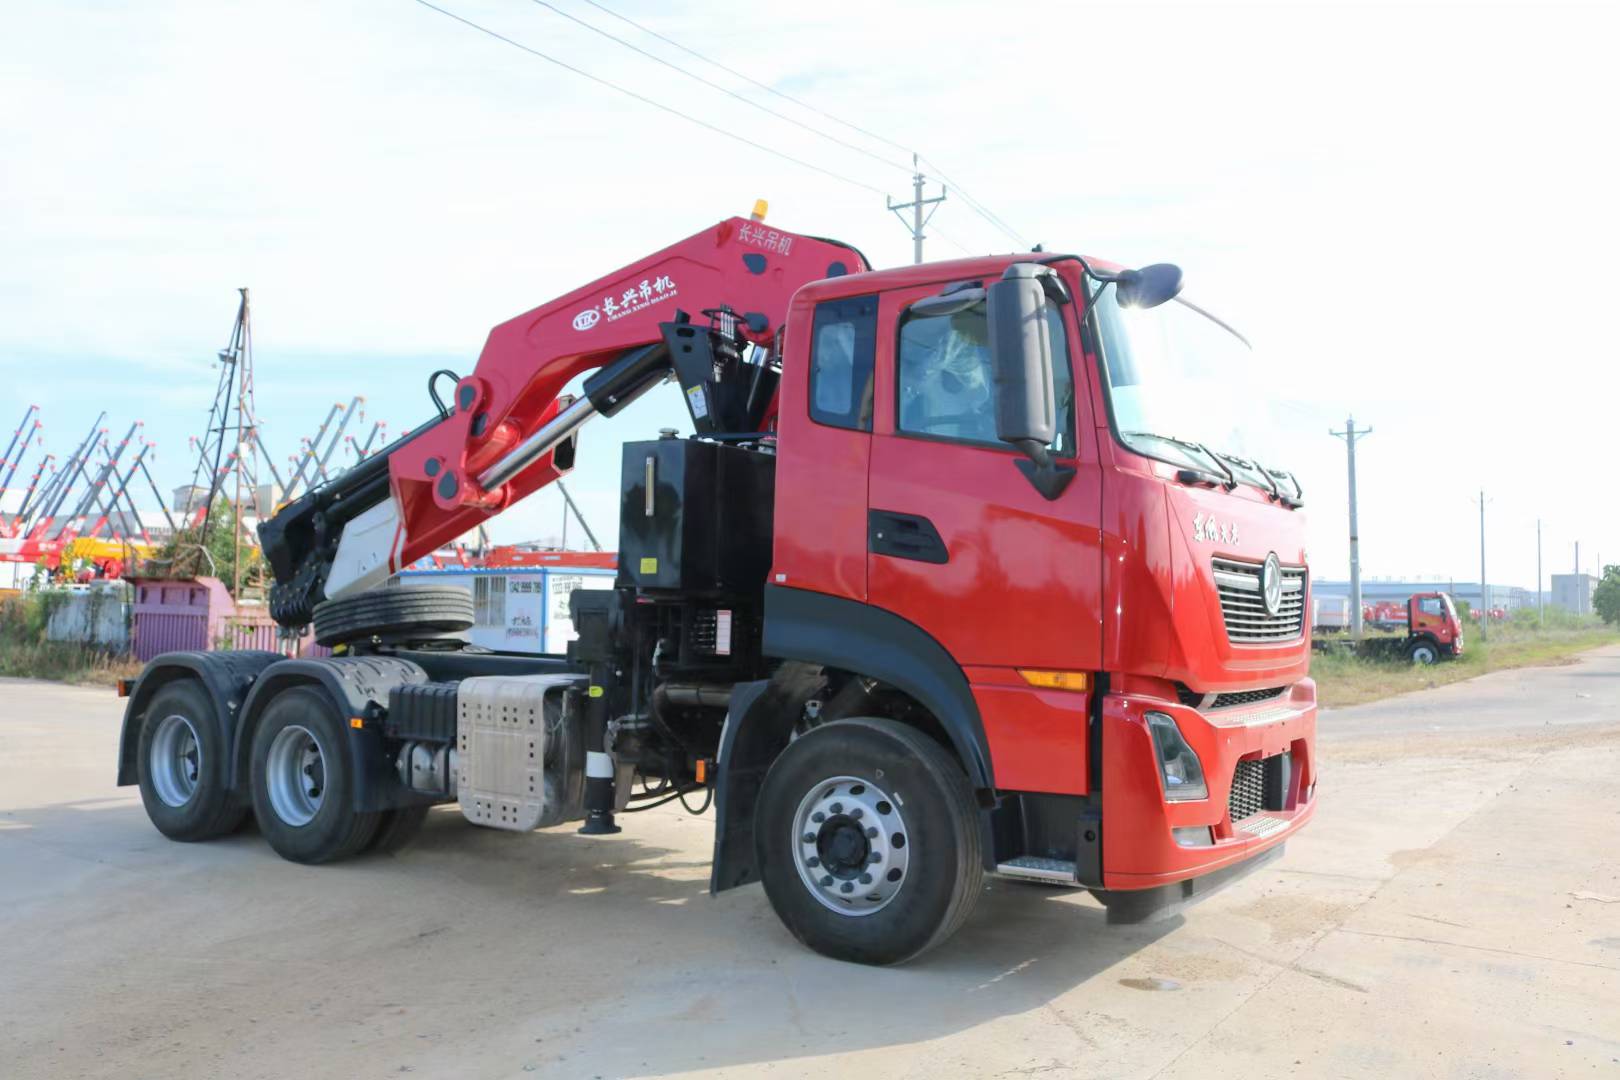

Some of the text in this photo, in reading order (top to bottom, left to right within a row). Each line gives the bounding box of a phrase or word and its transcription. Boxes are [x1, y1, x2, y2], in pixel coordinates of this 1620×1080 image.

[738, 223, 793, 256] 长兴吊机
[602, 275, 676, 316] 长兴吊机
